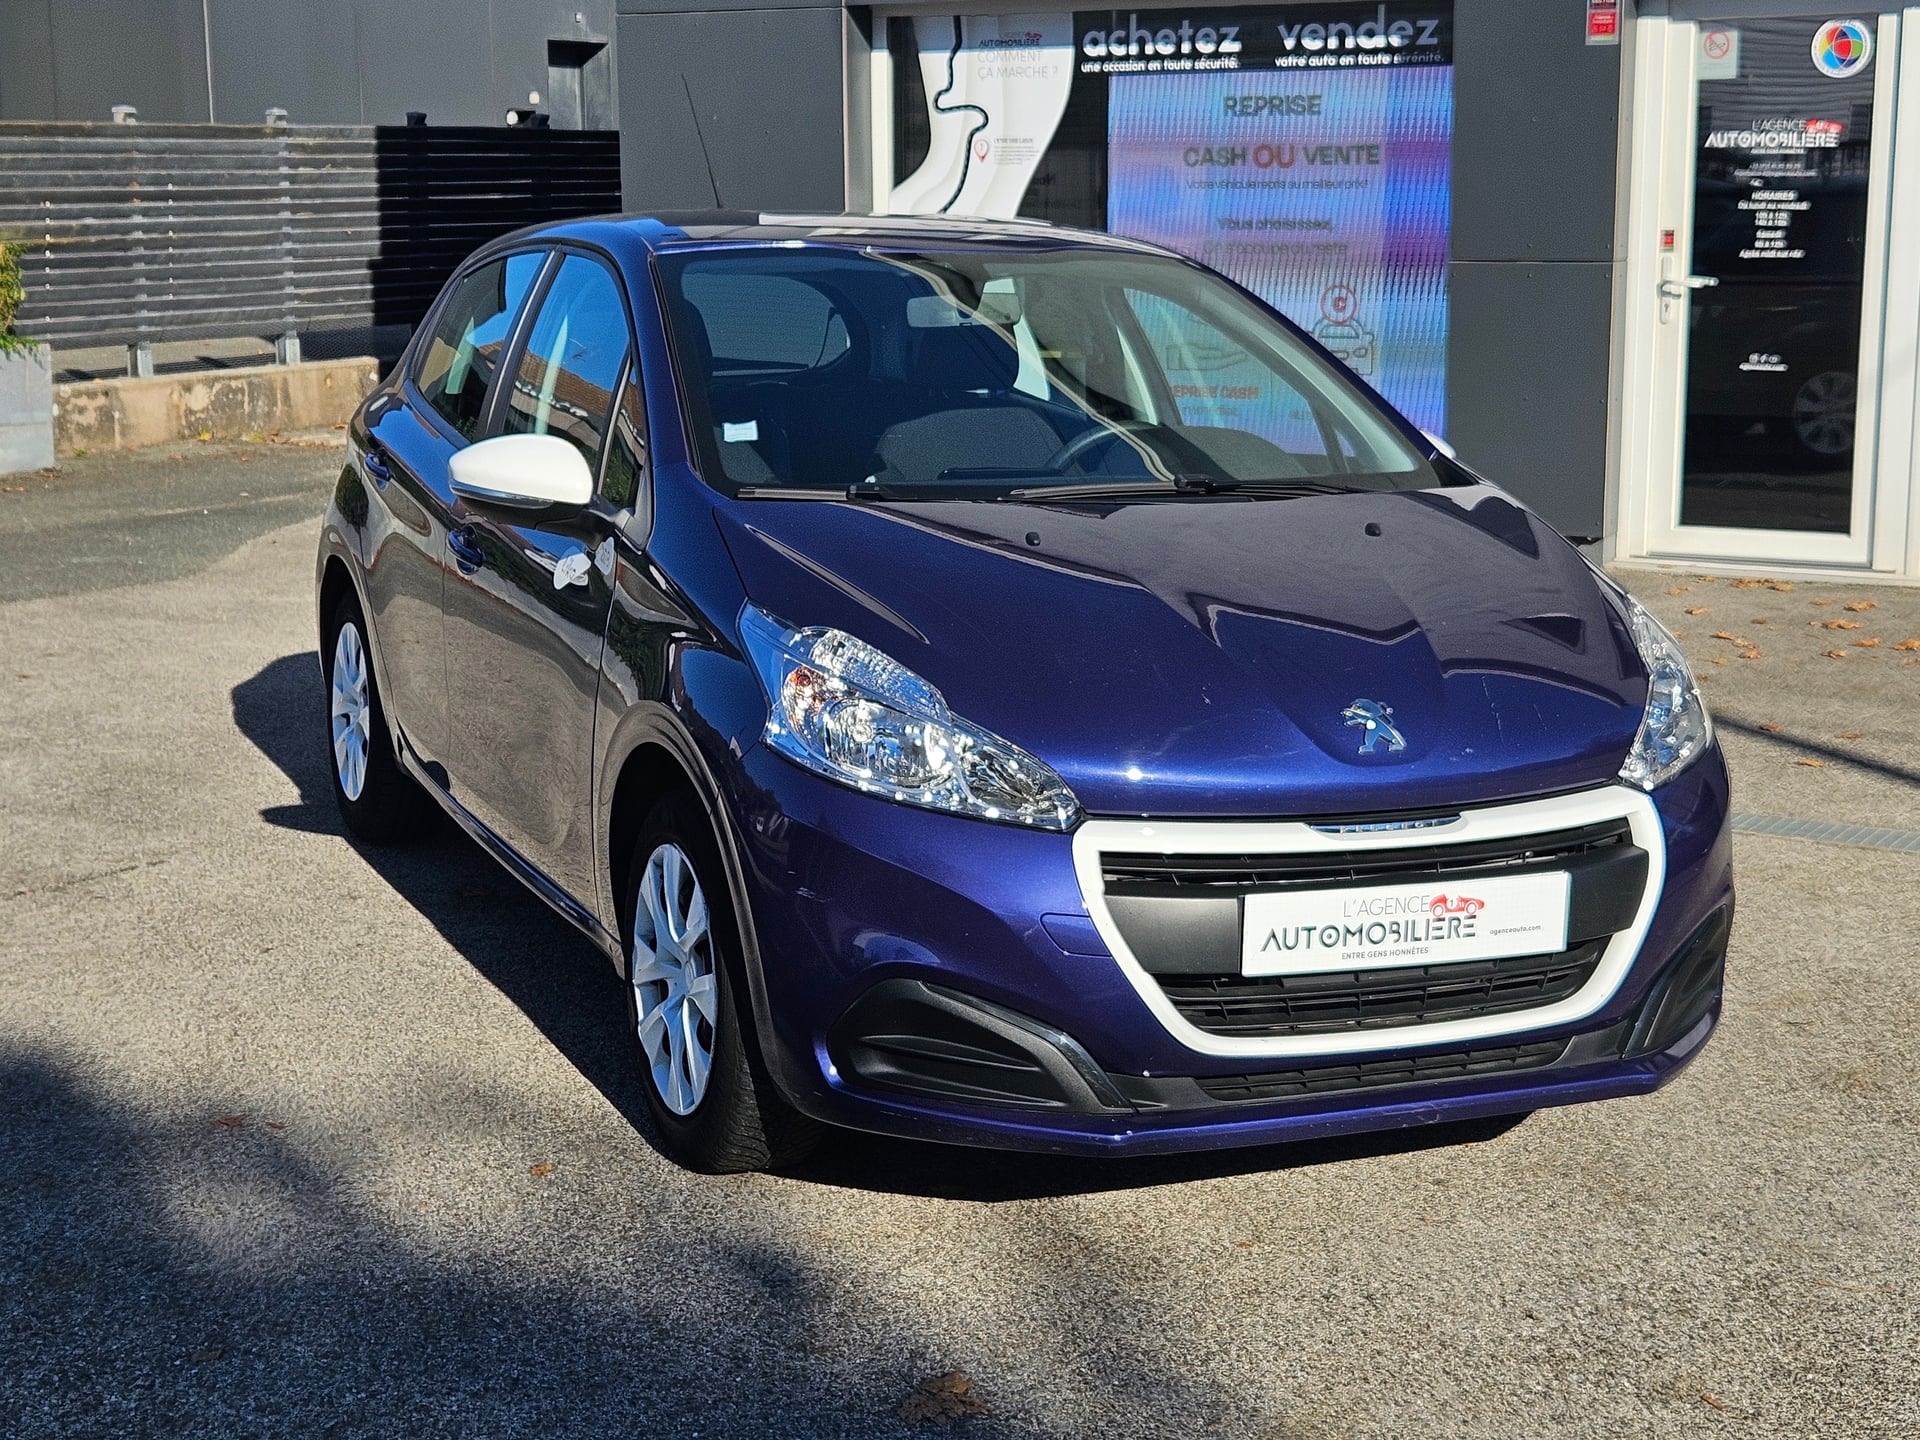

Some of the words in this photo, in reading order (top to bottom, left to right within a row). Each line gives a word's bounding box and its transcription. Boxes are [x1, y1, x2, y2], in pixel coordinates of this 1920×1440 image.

[1277, 4, 1439, 50] vendez
[1082, 13, 1242, 57] achetez
[977, 50, 1041, 63] COMMENT
[1081, 60, 1100, 72] une
[1102, 58, 1145, 72] occasion
[1148, 59, 1161, 71] en
[1163, 57, 1192, 71] toute
[1194, 55, 1239, 70] sécurité.
[1275, 54, 1307, 67] votre
[1309, 53, 1336, 66] auto
[1339, 54, 1355, 66] en
[1358, 52, 1390, 65] toute
[996, 66, 1049, 79] MARCHE
[1223, 94, 1322, 117] REPRISE
[1752, 119, 1806, 131] L'AGENCE
[1183, 147, 1247, 168] CASH
[1253, 143, 1295, 169] OU
[1302, 144, 1380, 165] VENTE
[1217, 217, 1253, 230] Vous
[1170, 384, 1218, 398] EPRISE
[1343, 895, 1431, 918] L'AGENCE
[1489, 924, 1541, 936] agenceauto.com
[1341, 951, 1366, 960] ENTRE
[1367, 949, 1388, 958] GENS
[1389, 945, 1429, 957] HONNÊTES
